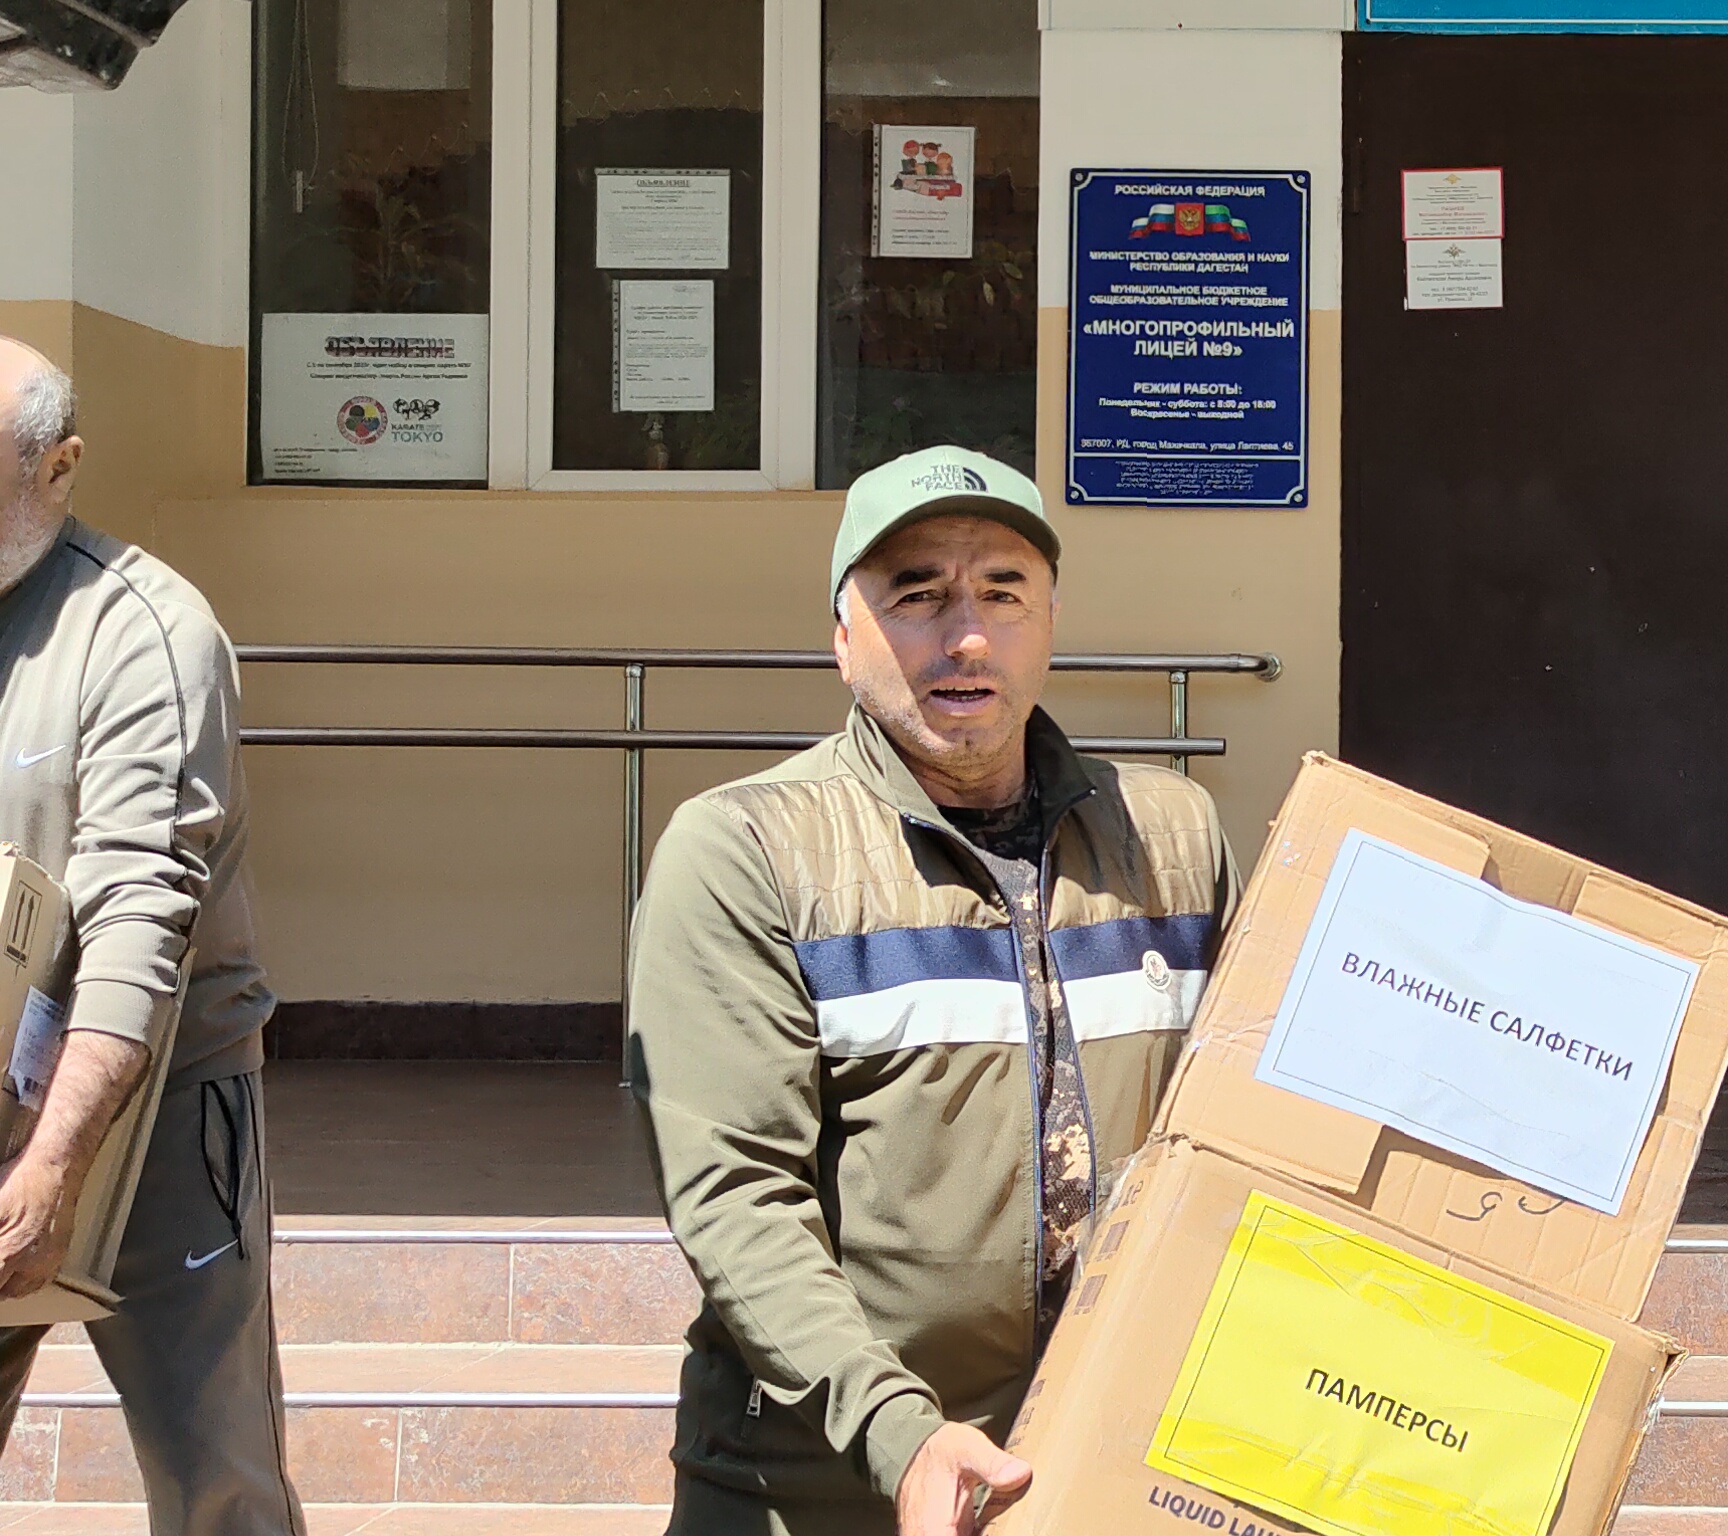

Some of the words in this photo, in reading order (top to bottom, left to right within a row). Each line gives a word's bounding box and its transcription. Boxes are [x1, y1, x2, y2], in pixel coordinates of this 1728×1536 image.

[1114, 183, 1193, 196] РОССИЙСКАЯ
[1195, 185, 1266, 198] ФЕДЕРАЦИЯ
[1090, 251, 1169, 260] МИНИСТЕРСТВО
[1172, 252, 1245, 261] ОБРАЗОВАНИЯ
[1257, 253, 1289, 262] НАУКИ
[1130, 263, 1194, 272] РЕСПУБЛИКИ
[1197, 263, 1248, 273] ДАГЕСТАН
[1111, 285, 1199, 295] МУНИЦИПАЛЬНОЕ
[1203, 286, 1267, 296] БЮДЖЕТНОЕ
[1089, 295, 1218, 305] ОБЩЕОБРАЗОВАТЕЛЬНОЕ
[1221, 297, 1288, 306] УЧРЕЖДЕНИЕ
[1083, 319, 1294, 338] «МНОГОПРОФИЛЬНЫЙ
[1134, 339, 1197, 359] ЛИЦЕЙ
[1203, 342, 1242, 357] №9»
[1134, 382, 1180, 394] РЕЖИМ
[1184, 383, 1242, 395] РАБОТЫ:
[392, 431, 443, 443] TOKYO
[930, 464, 960, 473] THE
[911, 473, 961, 487] NORTH
[925, 483, 963, 491] FACE
[1341, 951, 1486, 1024] ВЛАЖНЫЕ
[1489, 1010, 1633, 1082] САЛФЕТКИ
[1305, 1367, 1469, 1453] ПАМПЕРСЫ
[1149, 1485, 1226, 1530] LIQUID
